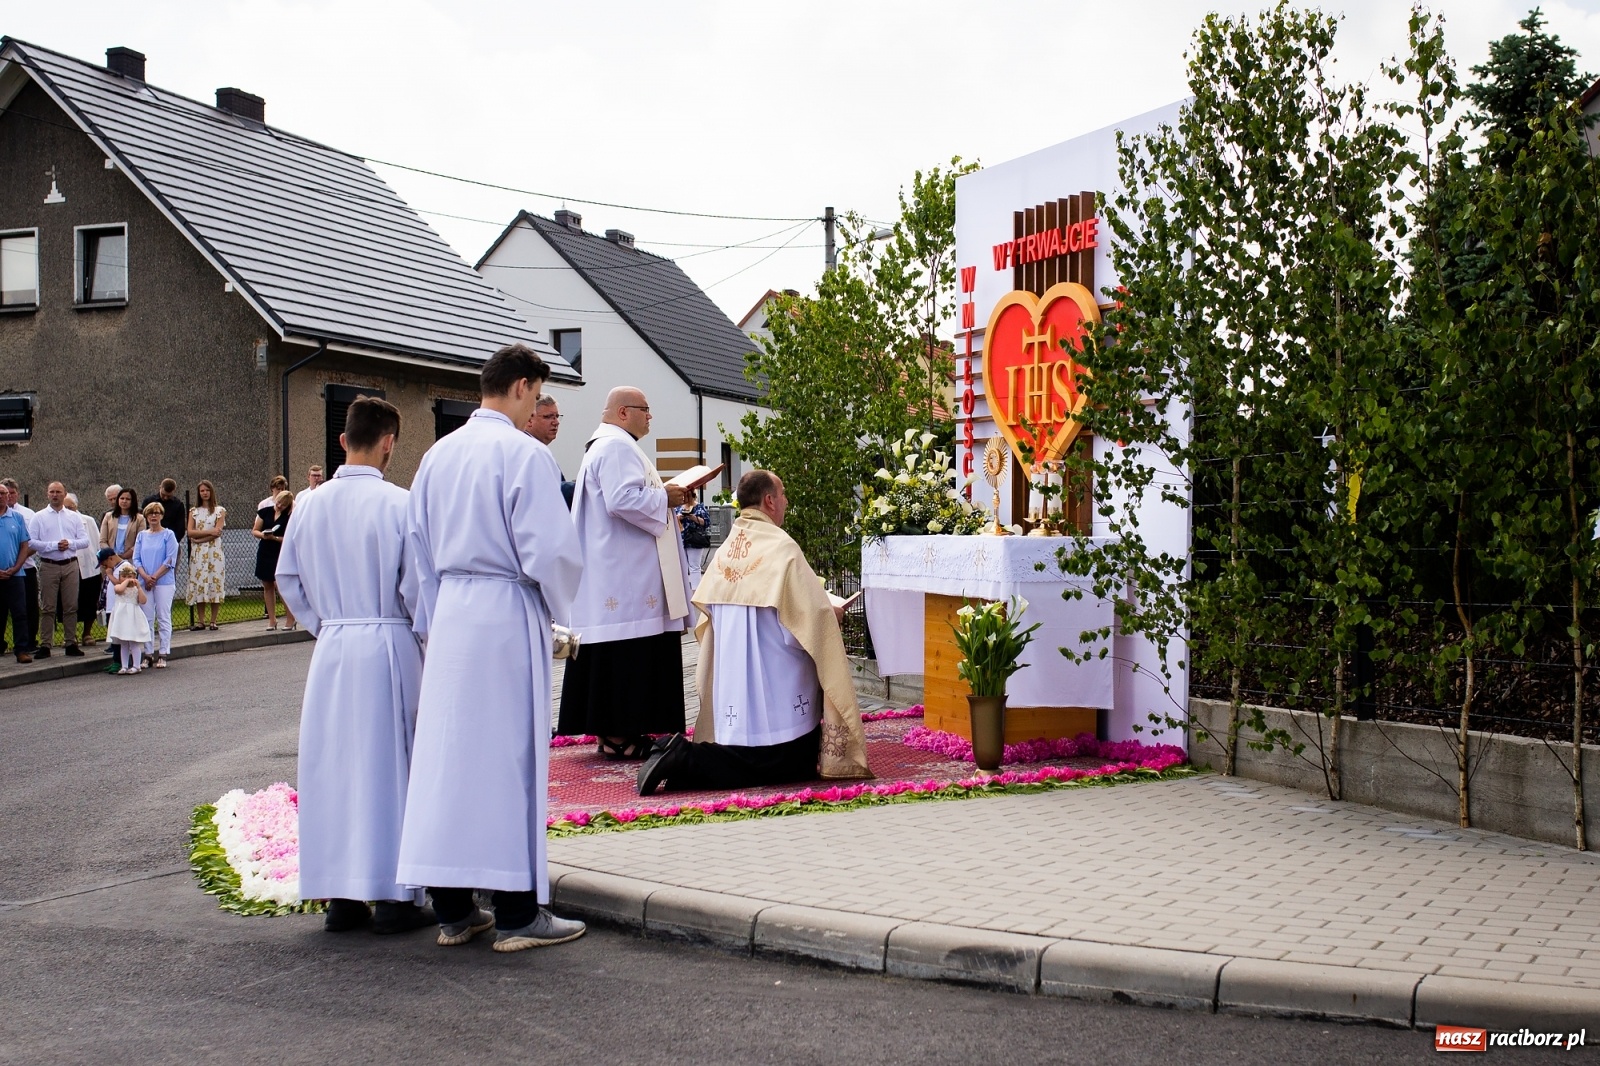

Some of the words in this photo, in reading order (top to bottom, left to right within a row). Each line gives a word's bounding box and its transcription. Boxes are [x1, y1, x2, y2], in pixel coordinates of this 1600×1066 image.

[992, 218, 1099, 271] WYTRWAJCIE
[960, 266, 976, 293] W
[1004, 359, 1074, 425] IHS
